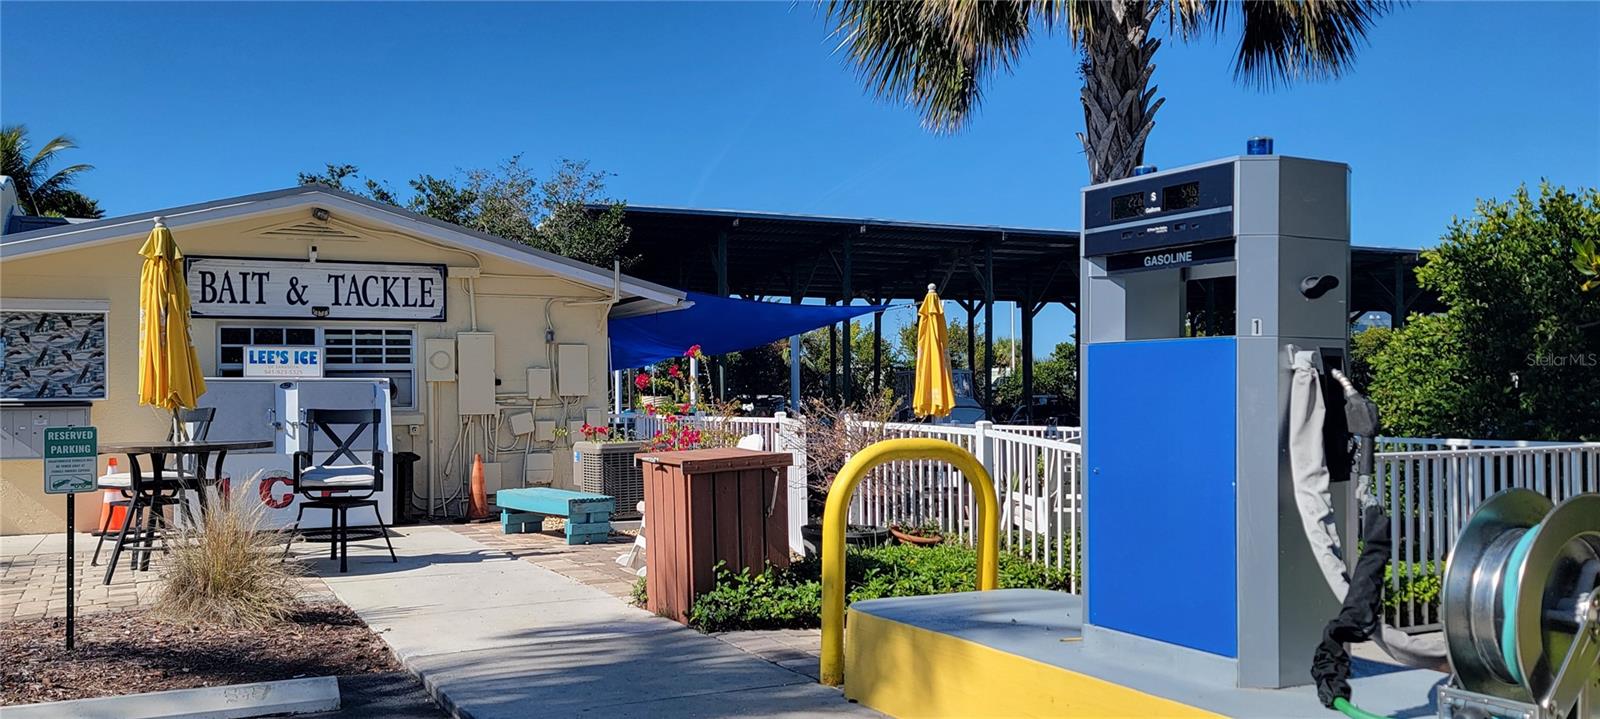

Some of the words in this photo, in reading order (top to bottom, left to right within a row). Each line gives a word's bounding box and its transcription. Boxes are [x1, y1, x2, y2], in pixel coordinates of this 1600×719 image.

[1144, 251, 1192, 267] GASOLINE
[199, 270, 270, 305] BAIT
[286, 276, 309, 306] &
[327, 273, 435, 308] TACKLE
[1254, 320, 1259, 334] 1
[249, 350, 289, 365] LEE'S
[294, 350, 318, 365] ICE
[48, 431, 93, 440] RESERVED
[51, 445, 91, 454] PARKING
